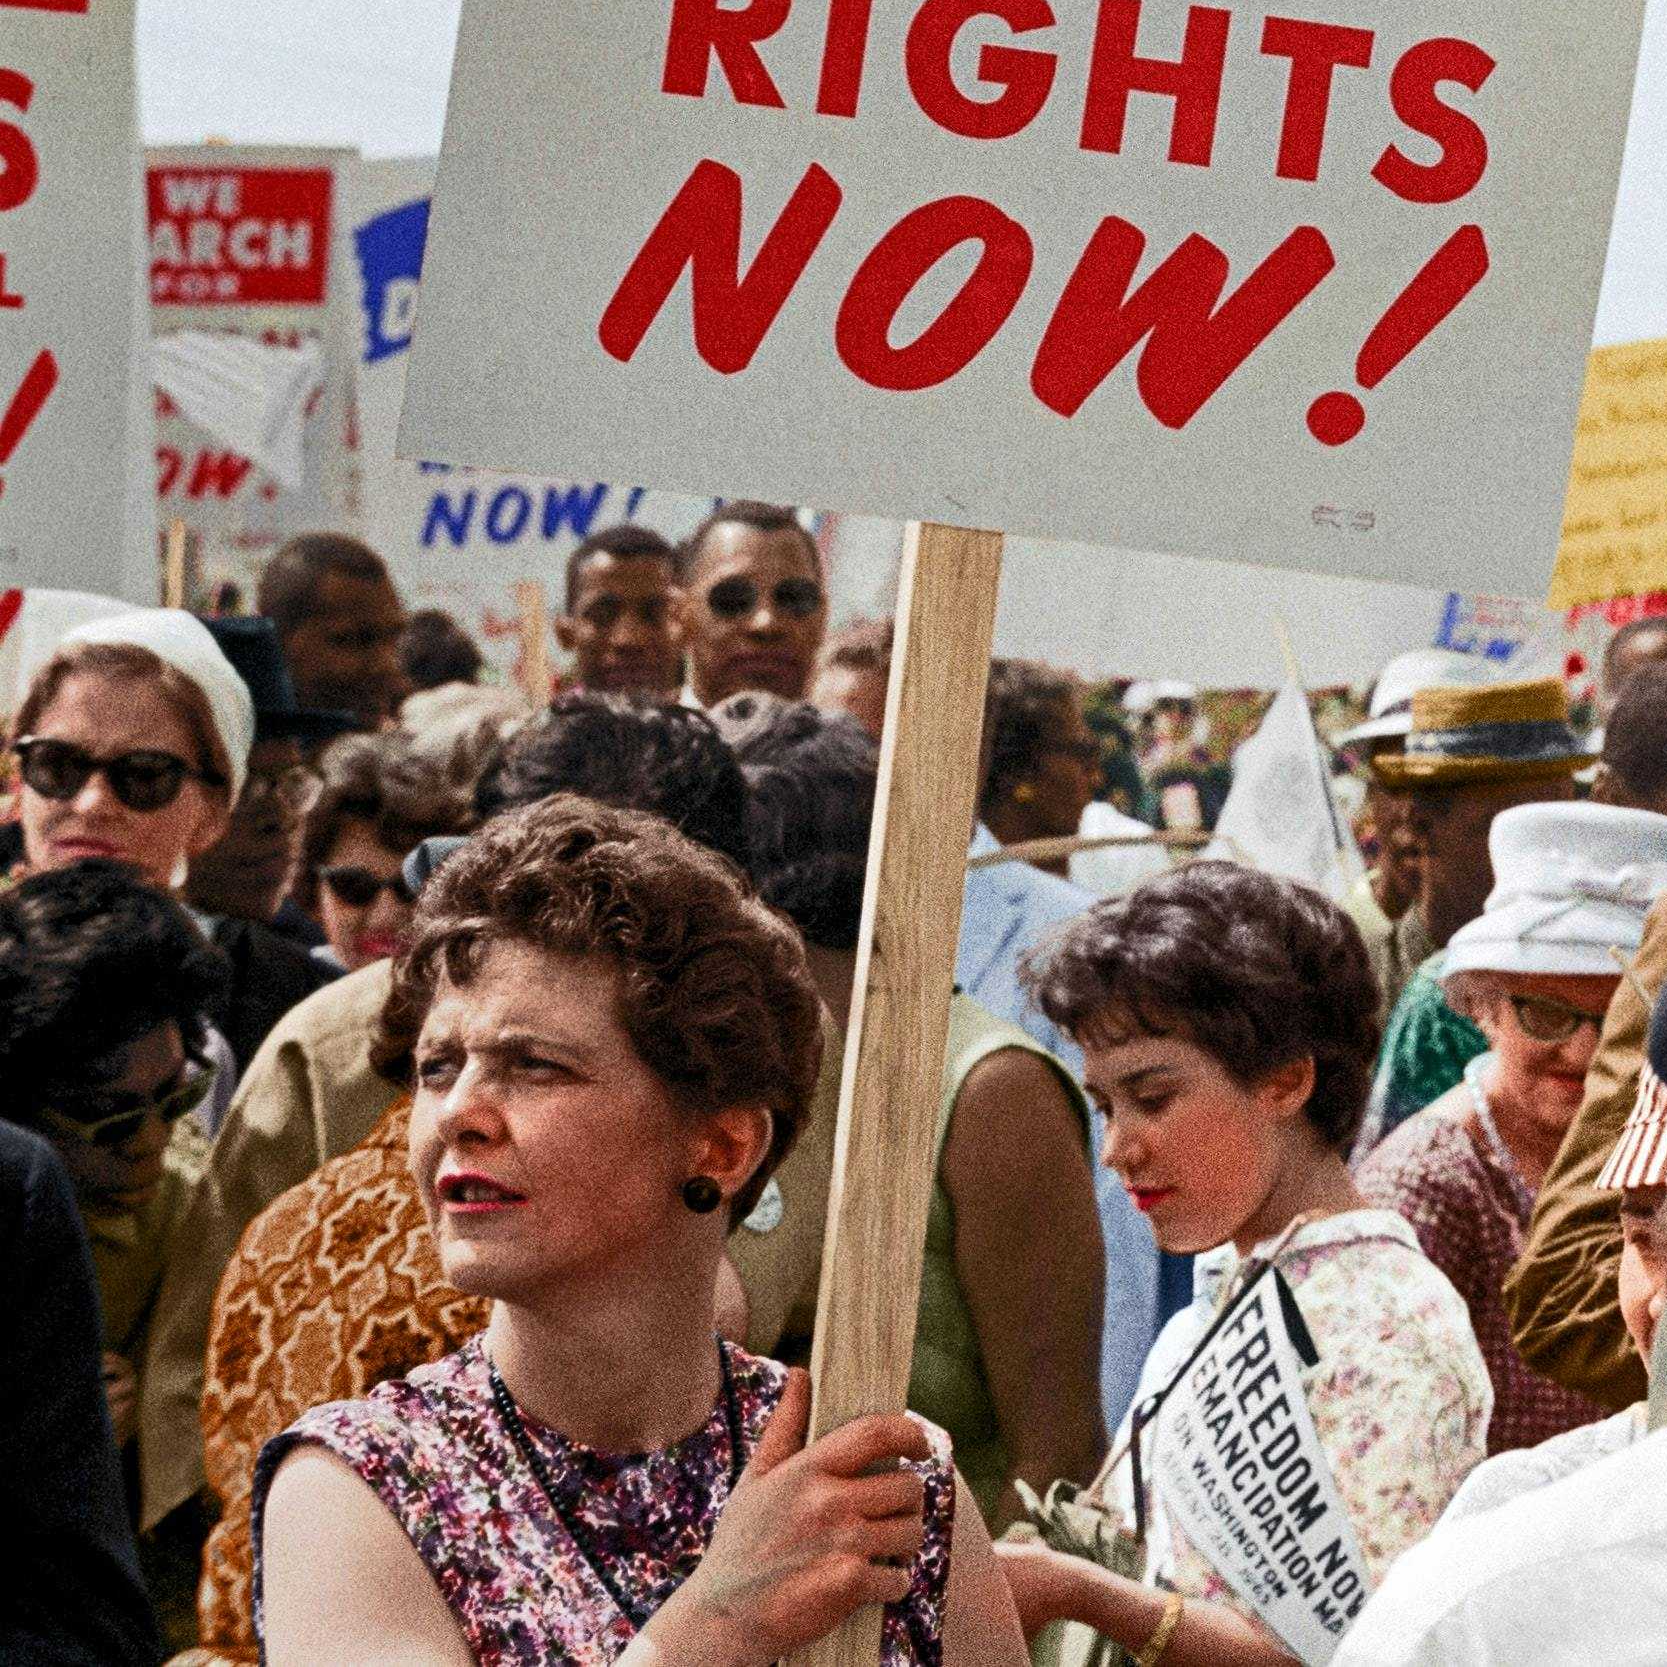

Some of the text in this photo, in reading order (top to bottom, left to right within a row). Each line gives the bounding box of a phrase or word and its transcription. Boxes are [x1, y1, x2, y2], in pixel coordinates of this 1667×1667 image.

[151, 218, 314, 270] ARCH
[597, 158, 1490, 448] NOW!
[1171, 1410, 1288, 1601] ON WASHINGTON
[1190, 1352, 1324, 1601] EMANCIPATION
[1222, 1294, 1329, 1531] FREEDOM
